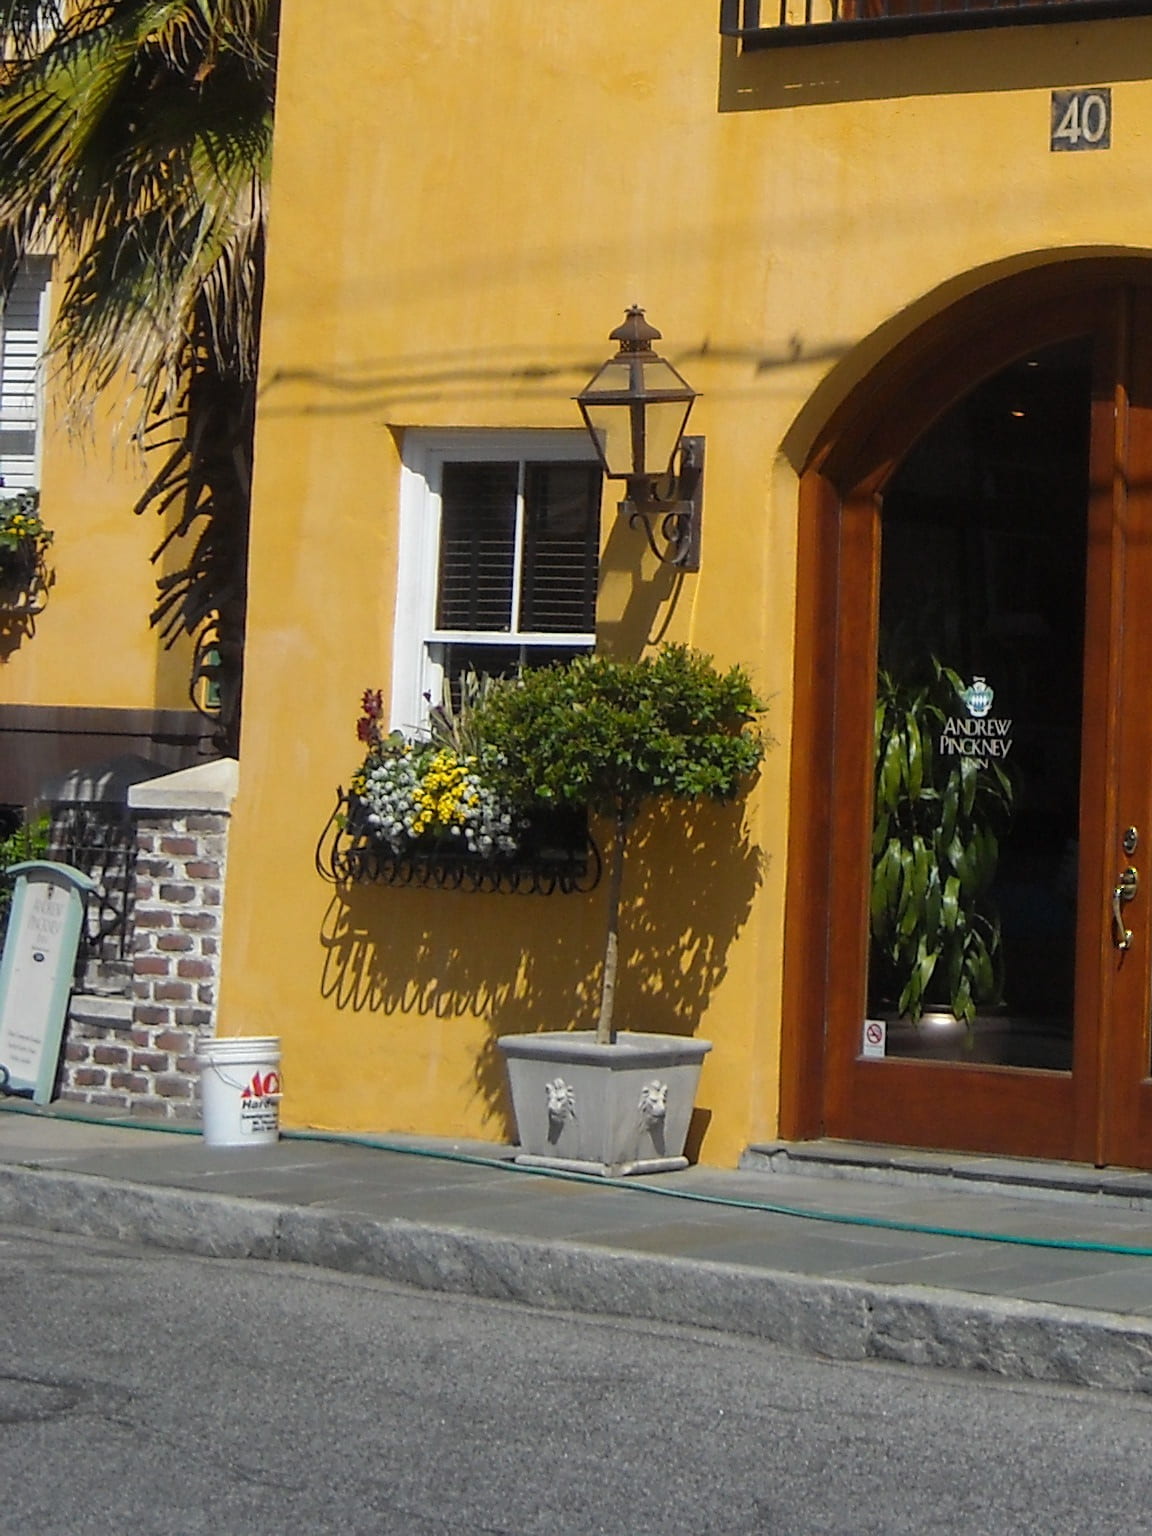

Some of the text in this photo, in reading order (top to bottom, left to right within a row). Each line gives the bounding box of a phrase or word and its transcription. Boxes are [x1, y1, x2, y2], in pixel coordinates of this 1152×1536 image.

[1053, 94, 1107, 144] 40
[942, 716, 1013, 737] ANDREW
[939, 735, 1014, 759] PINCKNEY
